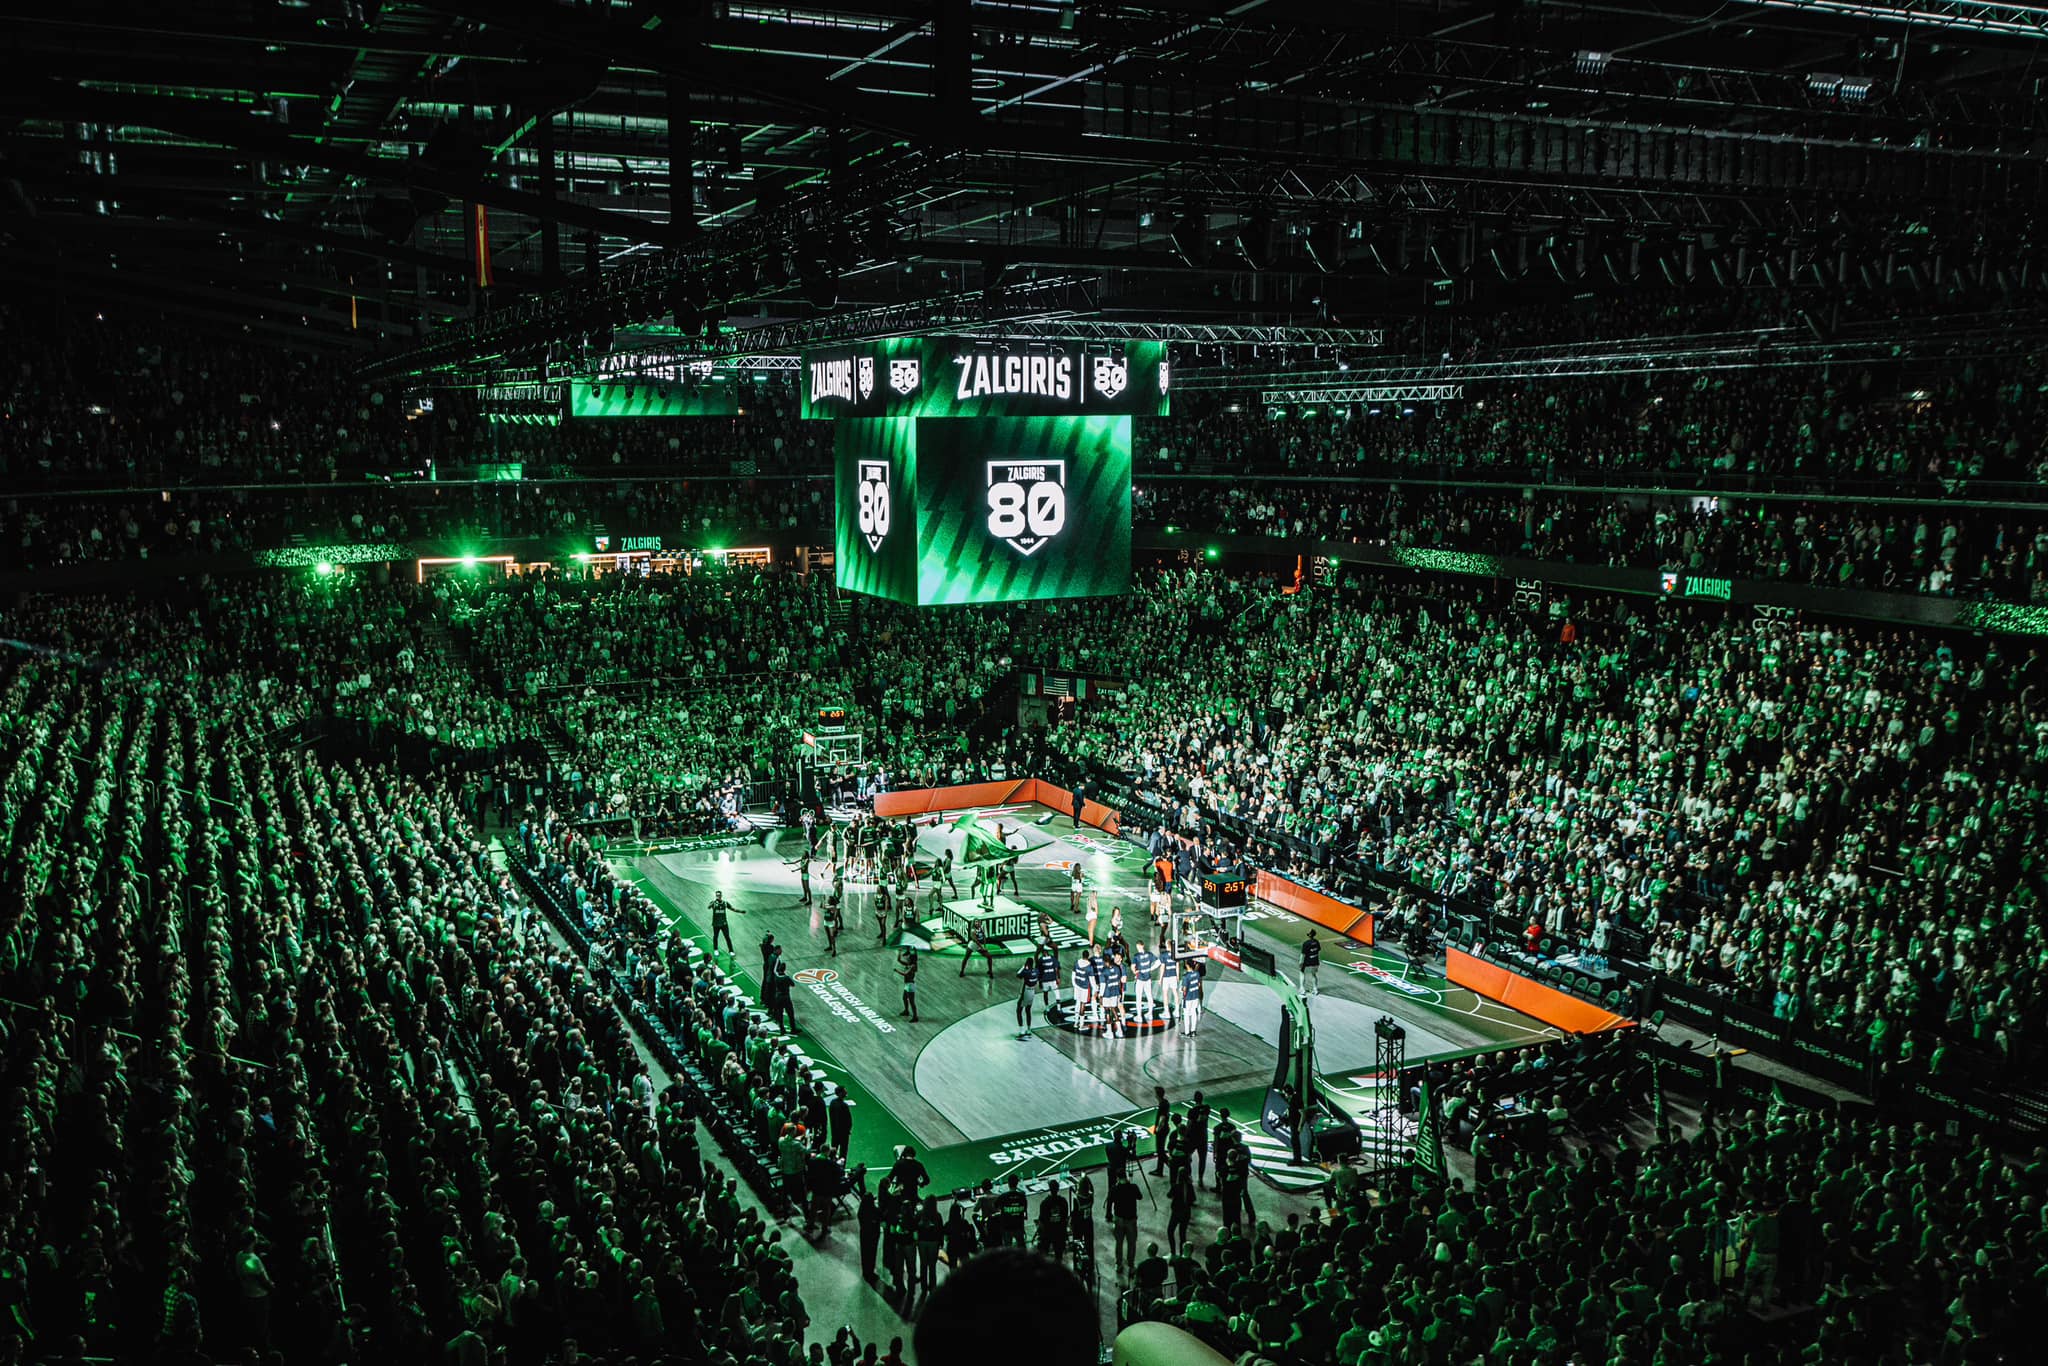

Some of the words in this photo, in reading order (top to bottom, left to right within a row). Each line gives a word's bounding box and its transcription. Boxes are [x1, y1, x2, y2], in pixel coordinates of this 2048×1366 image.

[811, 360, 852, 404] ZALGIRIS
[954, 355, 1071, 400] ZALGIRIS
[1094, 366, 1127, 391] 80
[1007, 466, 1046, 481] ZALGIRIS
[859, 481, 890, 536] 80
[988, 482, 1065, 538] 80
[620, 536, 662, 552] ZALGIRIS
[1684, 575, 1732, 600] ZALGIRIS
[981, 915, 1029, 939] ALGIRIS
[808, 983, 861, 1023] EuroLeague
[827, 980, 864, 1007] TURKISH
[855, 1006, 897, 1033] AIRLINES
